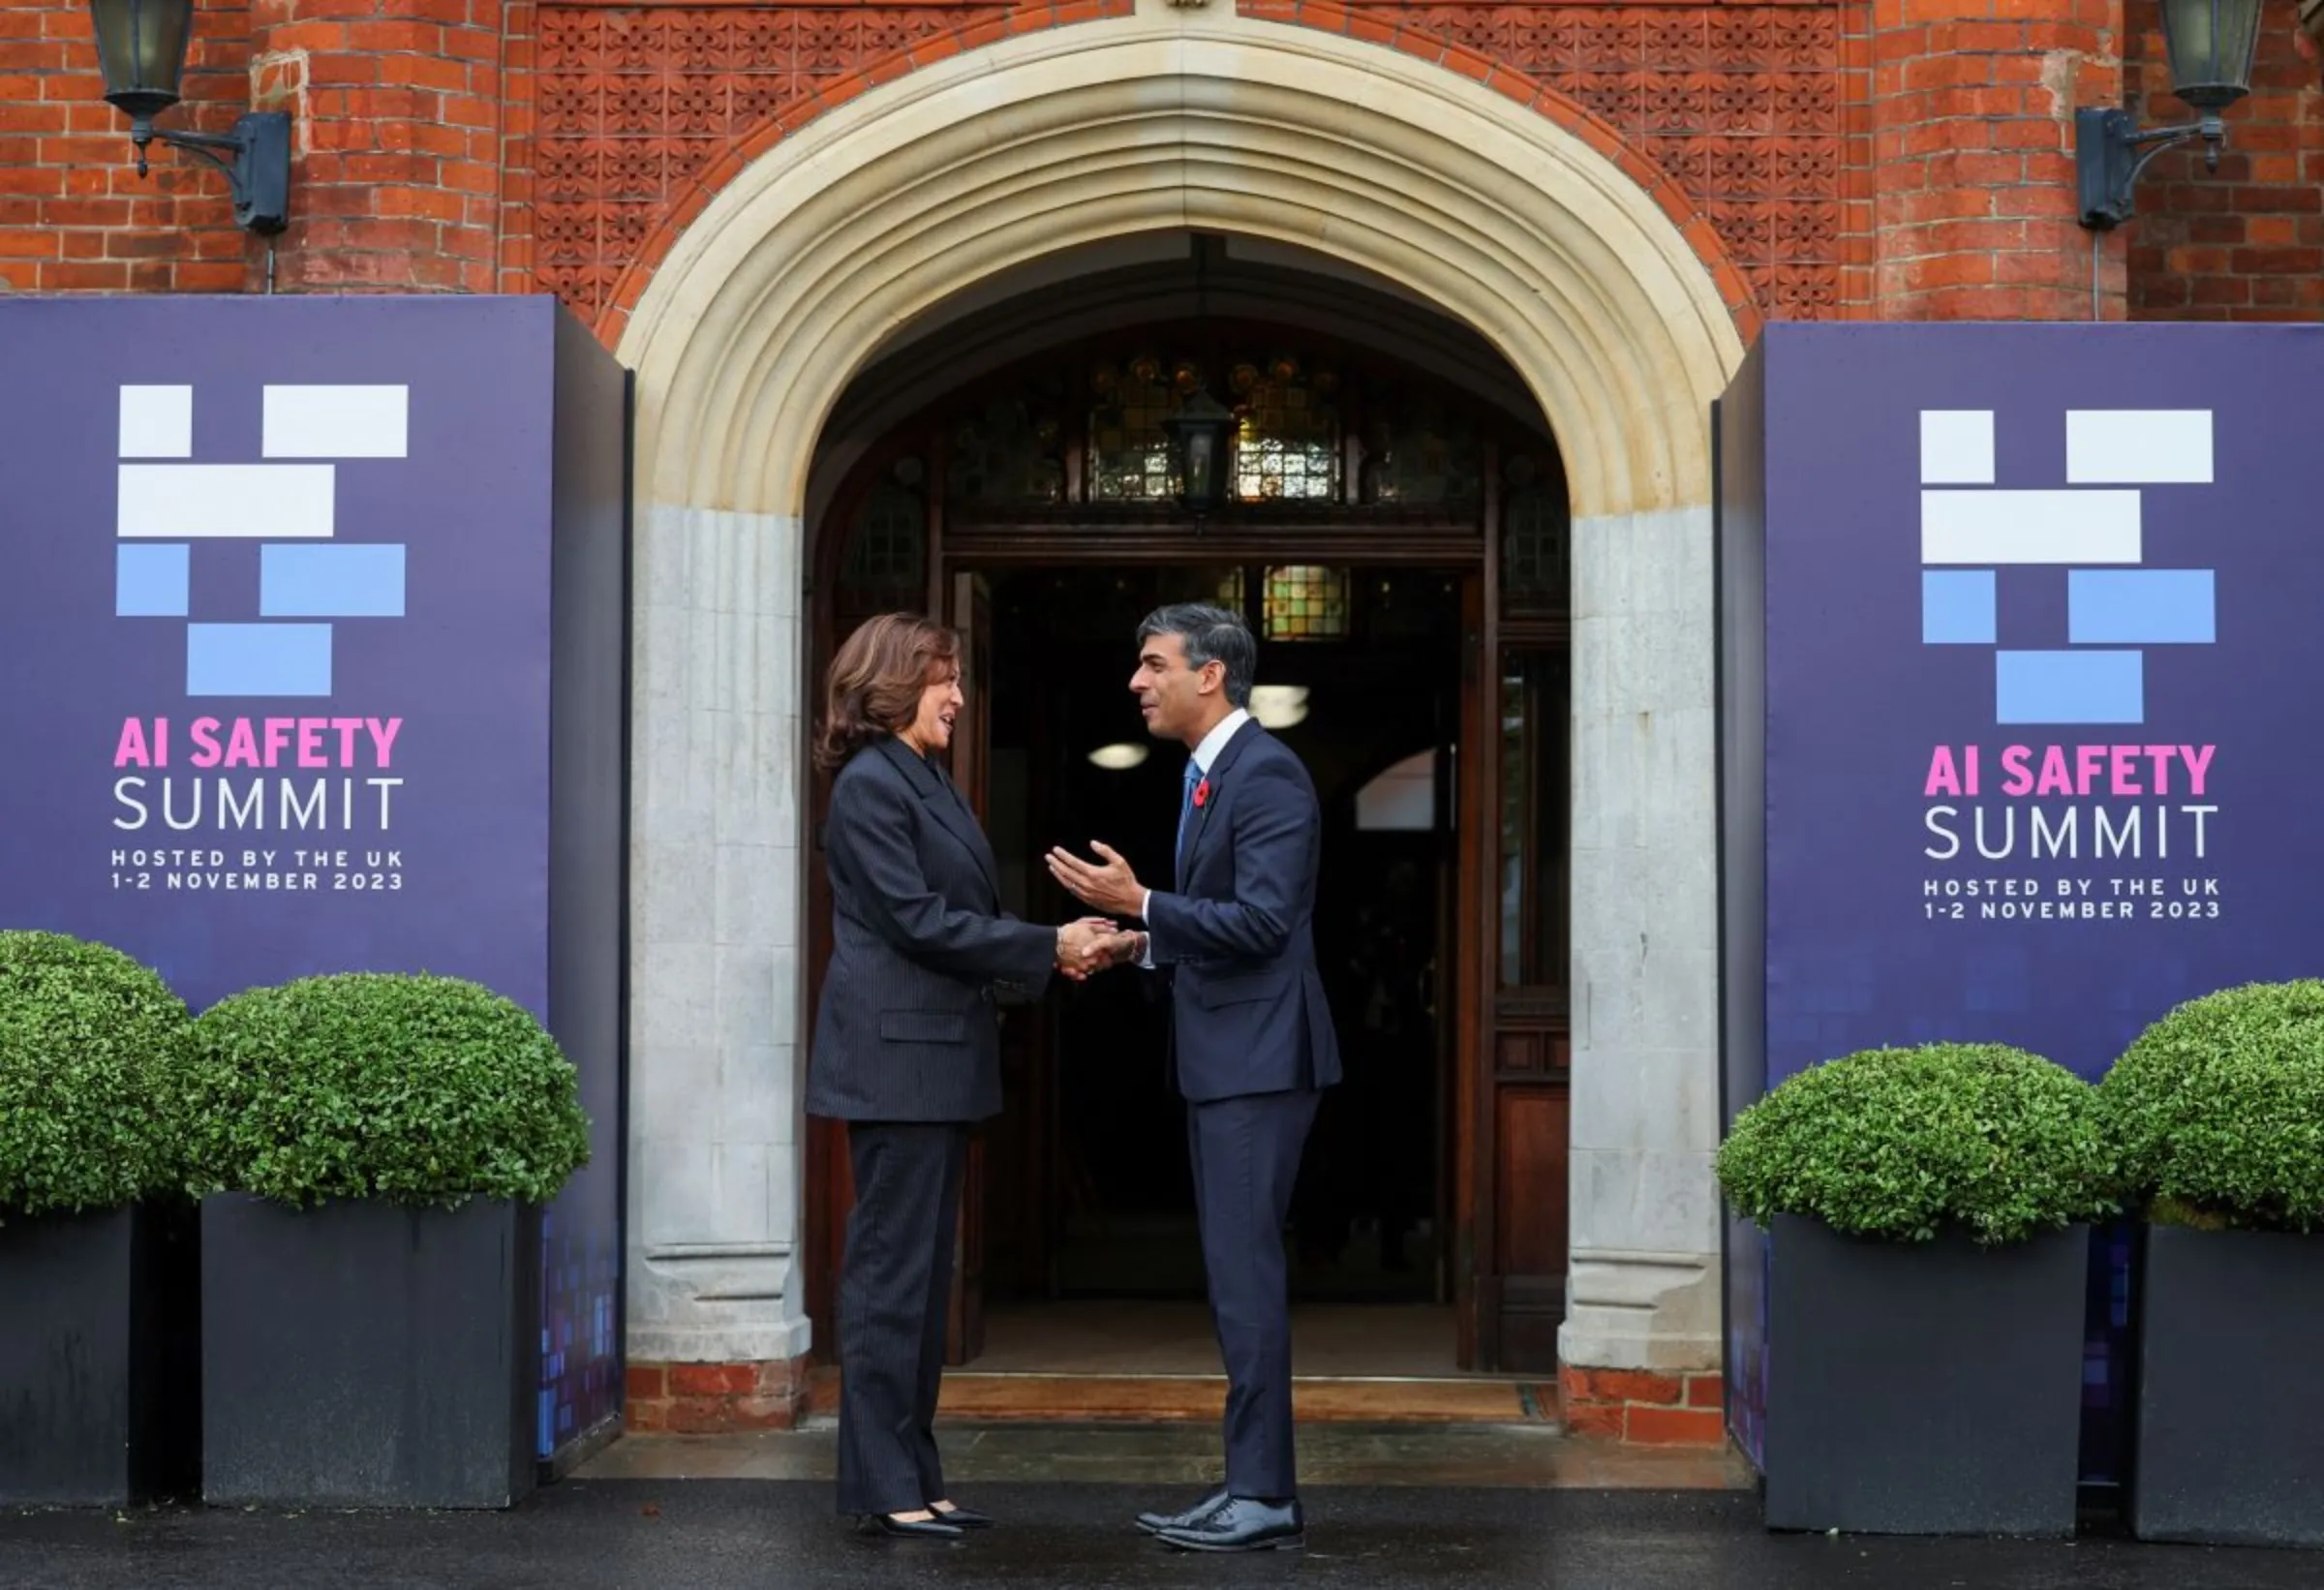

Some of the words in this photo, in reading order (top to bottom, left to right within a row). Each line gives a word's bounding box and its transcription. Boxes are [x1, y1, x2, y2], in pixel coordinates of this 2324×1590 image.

[114, 718, 168, 767] AI
[191, 717, 402, 767] SAFETY
[1925, 746, 1978, 795] AI
[2002, 745, 2216, 796] SAFETY
[114, 777, 403, 830] SUMMIT
[1925, 806, 2217, 859] SUMMIT
[112, 850, 224, 866] HOSTED
[243, 850, 275, 866] BY
[294, 850, 347, 867] THE
[368, 851, 401, 867] UK
[112, 872, 150, 888] 1-2
[168, 873, 317, 889] NOVEMBER
[334, 873, 401, 890] 2023
[1925, 879, 2037, 896] HOSTED
[2058, 879, 2091, 896] BY
[2111, 879, 2163, 895] THE
[2184, 879, 2218, 895] UK
[1925, 902, 1964, 918] 1-2
[1982, 902, 2133, 918] NOVEMBER
[2151, 902, 2218, 918] 2023
